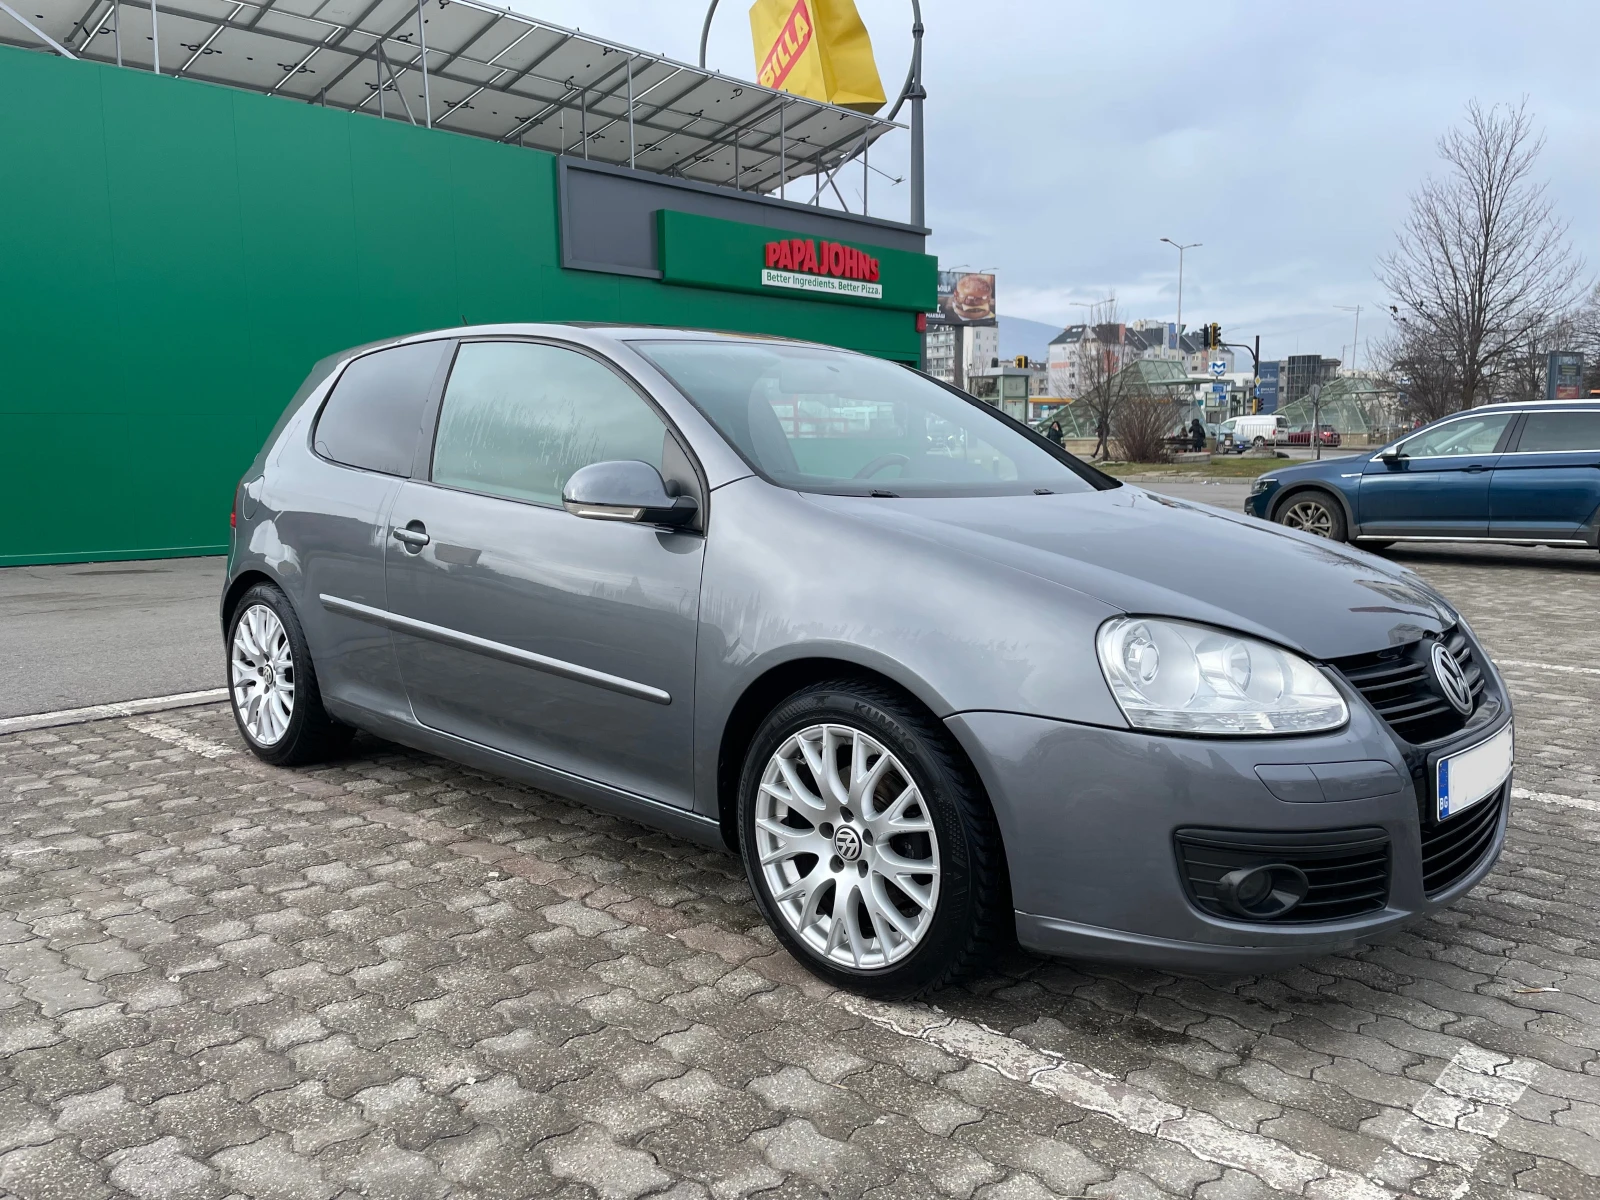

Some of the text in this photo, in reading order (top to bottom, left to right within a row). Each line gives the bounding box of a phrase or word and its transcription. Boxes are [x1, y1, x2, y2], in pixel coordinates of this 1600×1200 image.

[760, 12, 810, 87] BILLA
[765, 238, 819, 273] PAPA
[766, 271, 881, 295] Better Ingredients. Better Pizza.
[853, 701, 918, 755] KUMHO
[1439, 795, 1449, 811] BG
